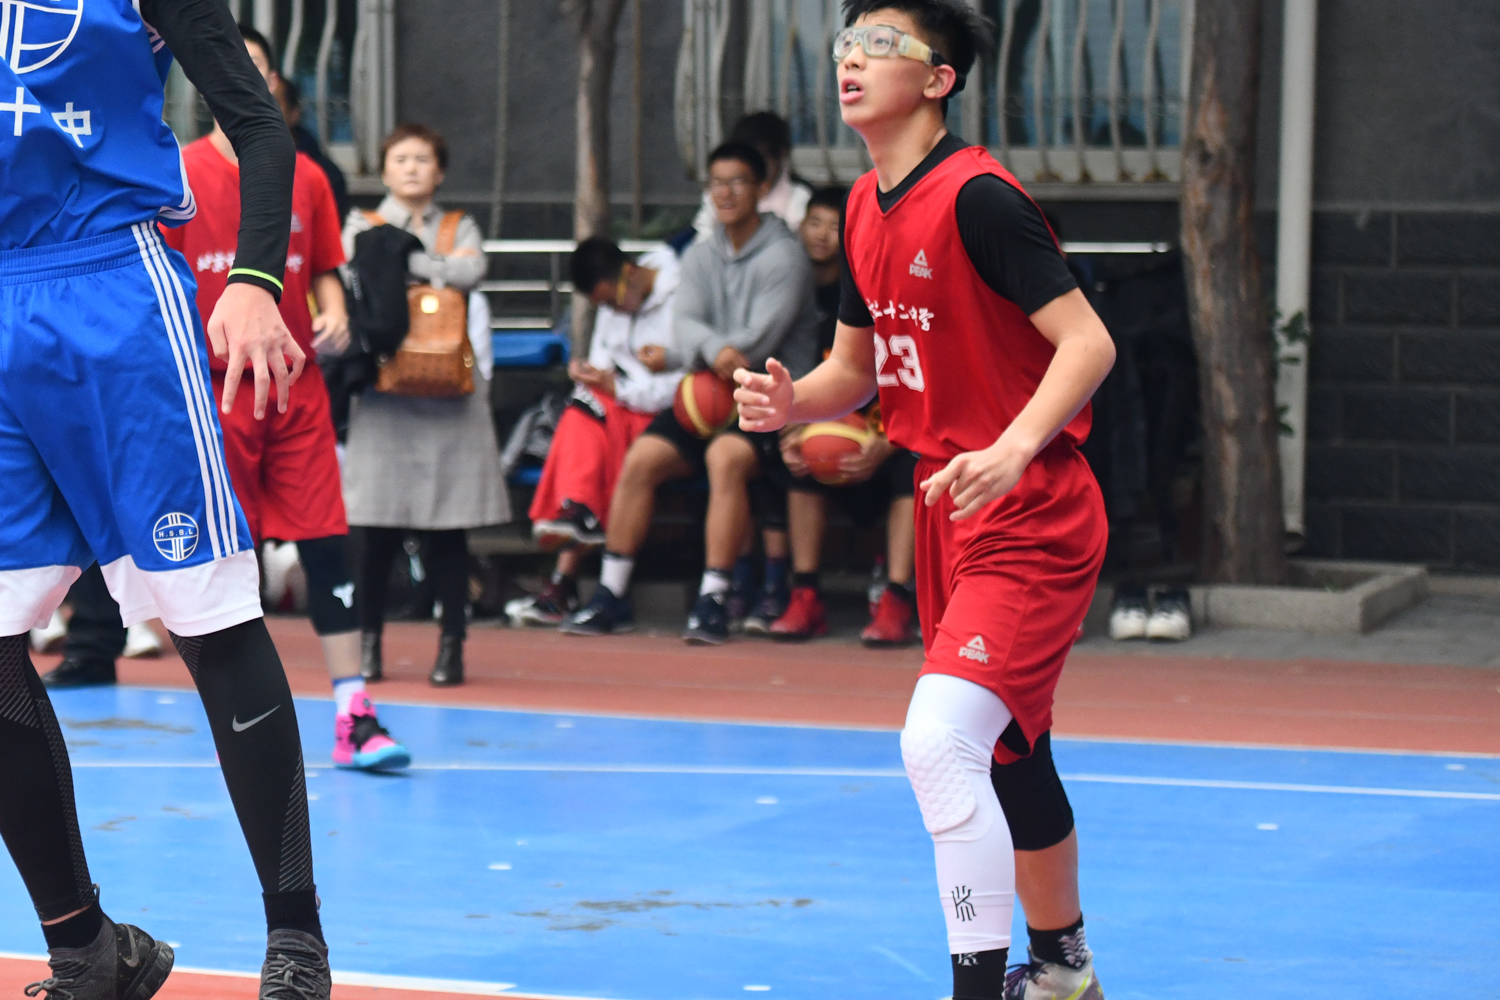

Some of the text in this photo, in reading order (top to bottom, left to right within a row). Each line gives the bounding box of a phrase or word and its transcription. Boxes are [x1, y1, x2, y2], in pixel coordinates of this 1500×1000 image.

[909, 263, 933, 280] PEAK
[874, 332, 925, 393] 23
[958, 645, 991, 665] PEAK
